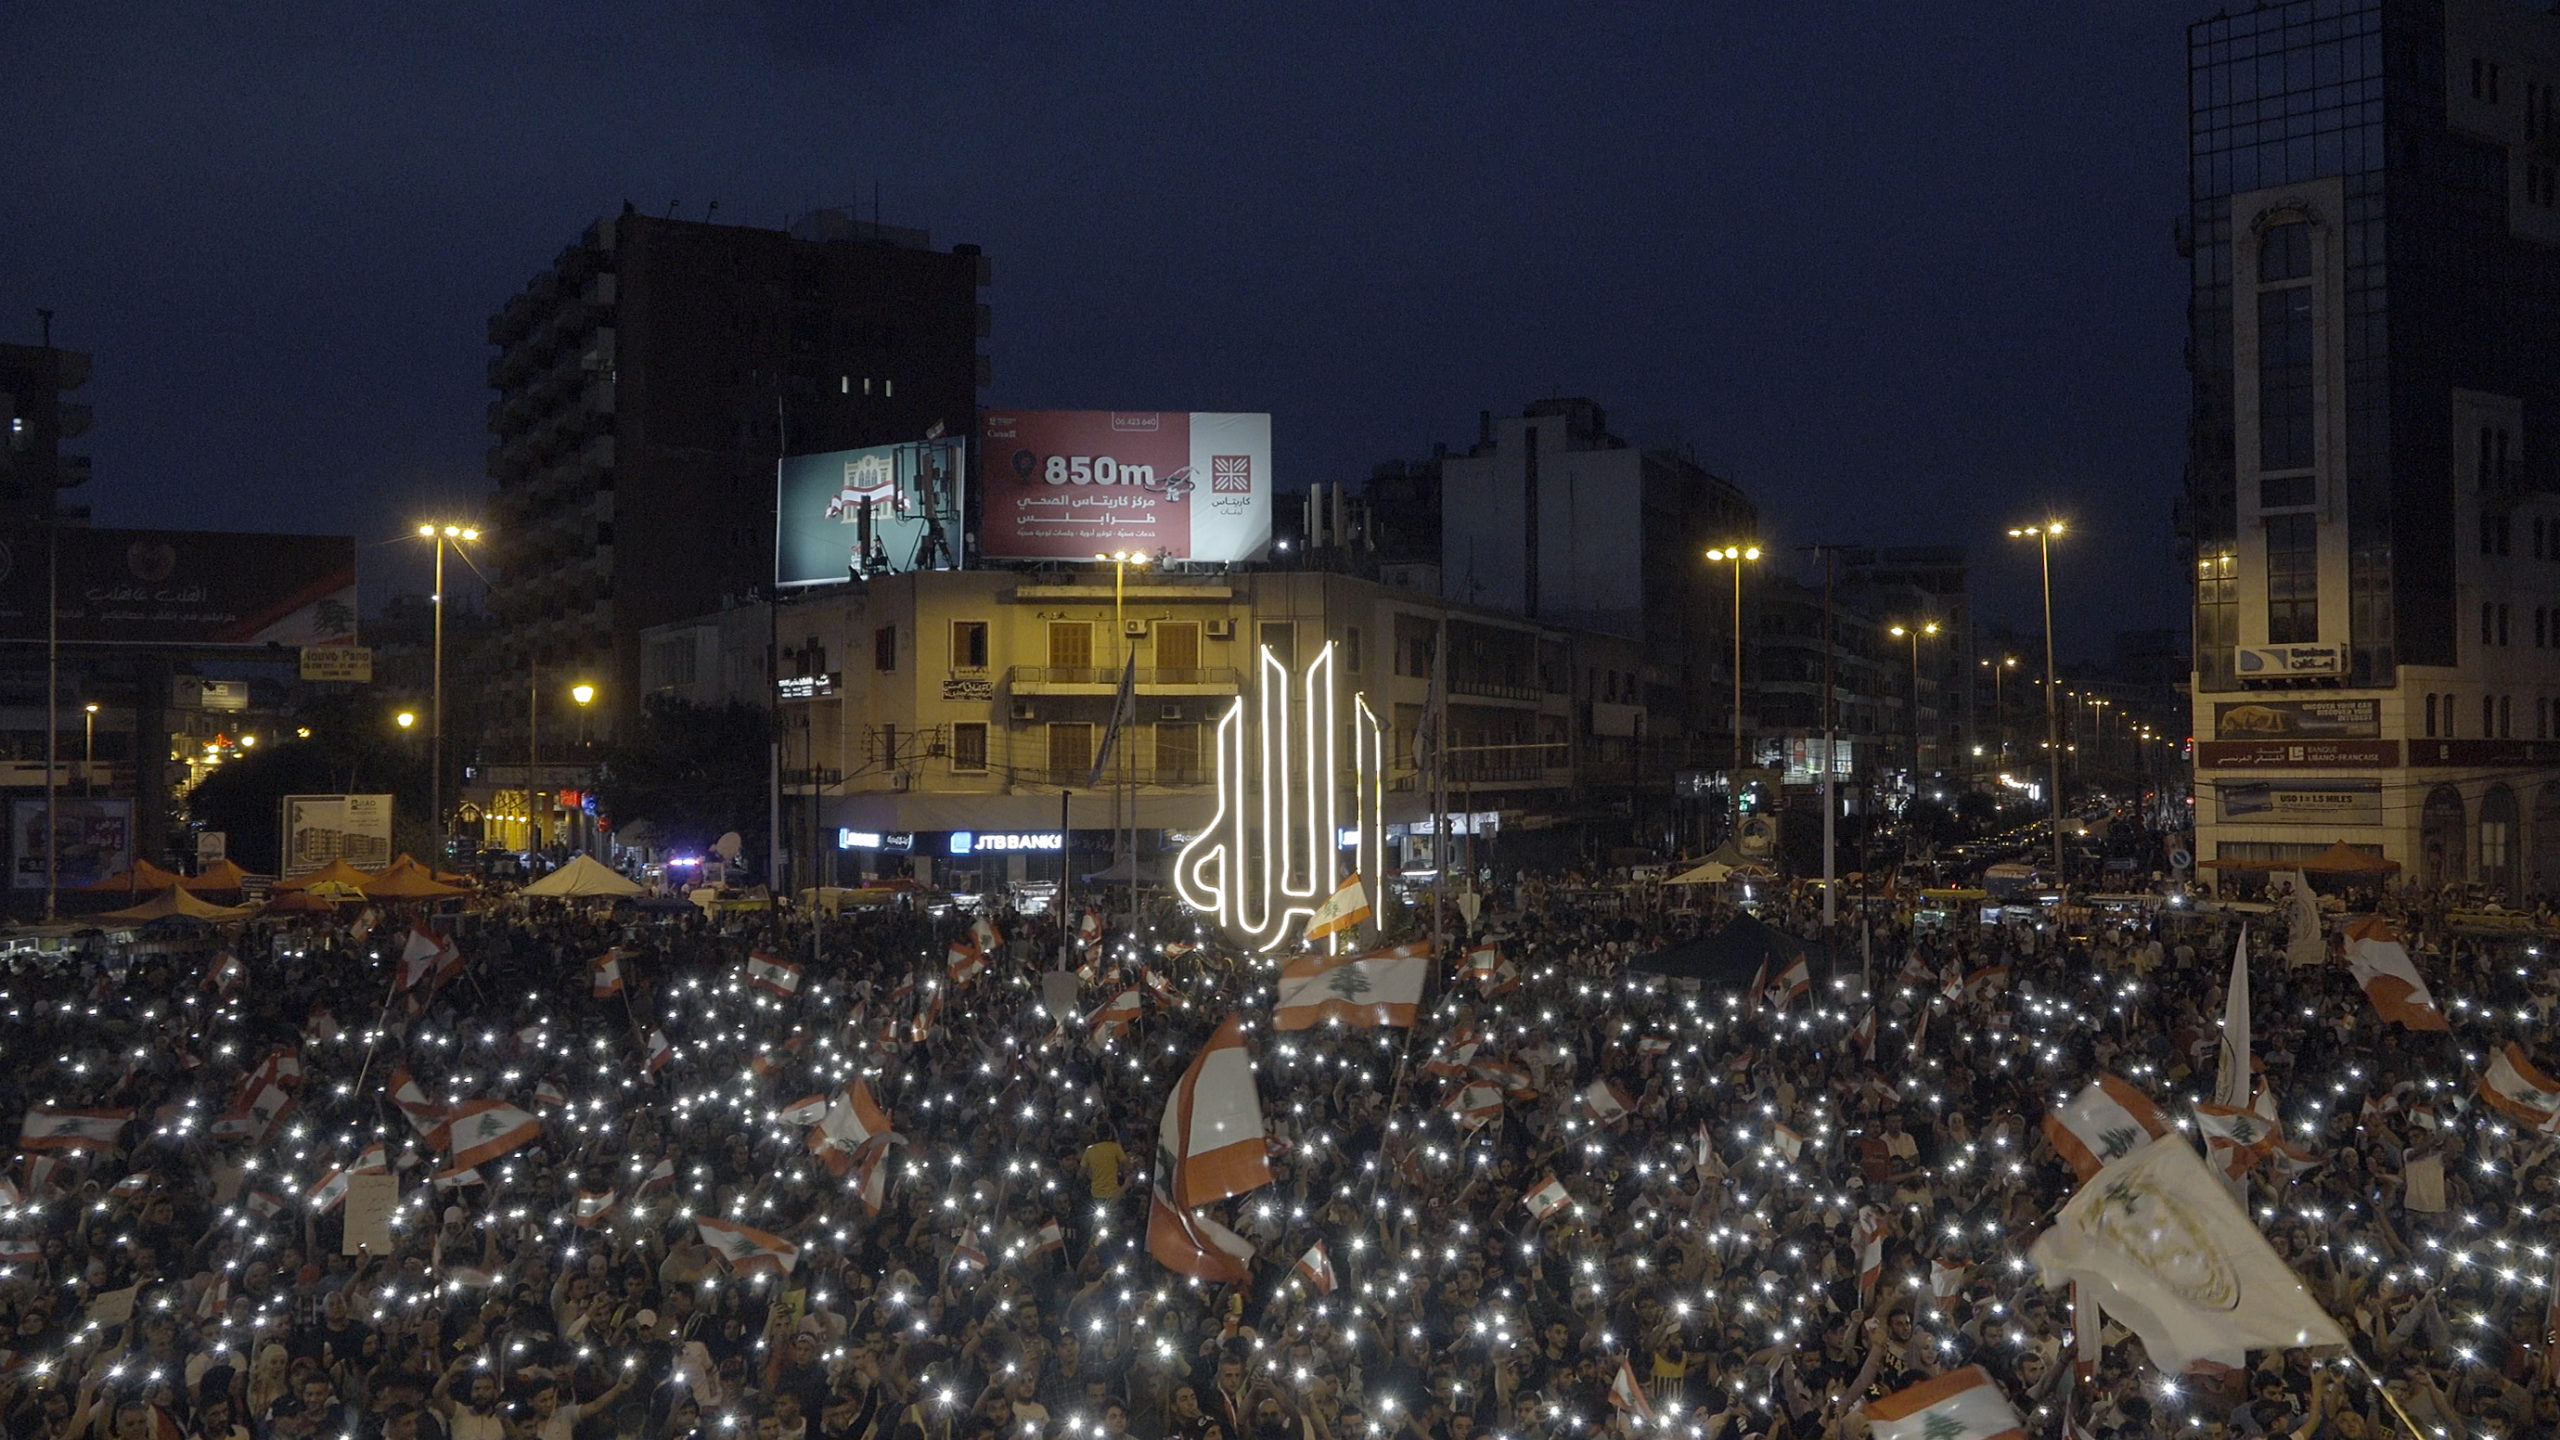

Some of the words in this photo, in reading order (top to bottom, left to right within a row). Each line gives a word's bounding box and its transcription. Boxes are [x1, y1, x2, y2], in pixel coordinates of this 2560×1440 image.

[1044, 455, 1156, 486] 850m
[1016, 495, 1069, 510] الصحي
[1072, 495, 1128, 509] كاريتاس
[1131, 496, 1156, 509] مركز
[1211, 496, 1251, 508] كاريتاس
[1016, 512, 1156, 526] طرابلس
[2326, 795, 2353, 803] MILES
